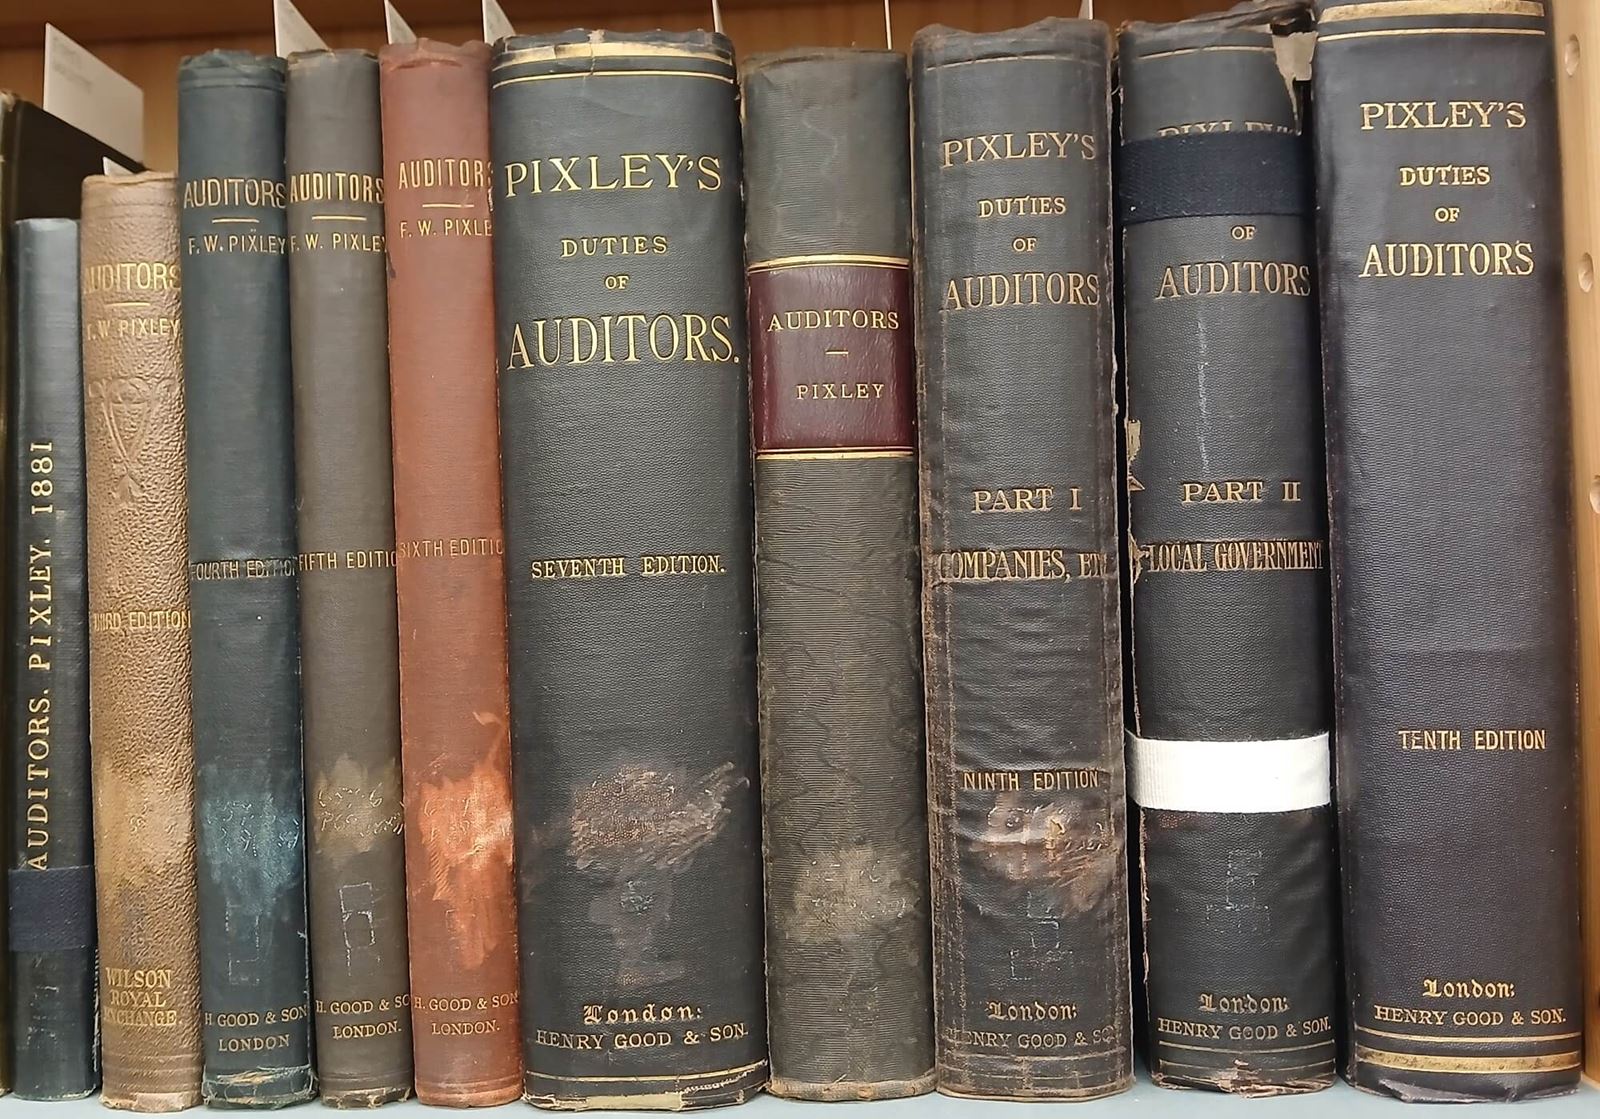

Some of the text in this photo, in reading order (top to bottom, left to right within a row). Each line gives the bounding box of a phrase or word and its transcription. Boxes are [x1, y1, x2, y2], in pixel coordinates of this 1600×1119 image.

[1360, 101, 1527, 130] PIXLEY'S
[941, 132, 1097, 169] PIXLEY'S
[504, 154, 722, 198] PIXLEY'S
[1399, 165, 1490, 186] DUTIES
[183, 178, 288, 209] AUDITORS
[289, 172, 384, 204] AUDITORS
[978, 196, 1067, 218] DUTIES
[1434, 207, 1460, 222] OF
[400, 222, 412, 238] F.
[418, 220, 437, 236] W.
[1231, 226, 1257, 240] OF
[188, 235, 286, 255] F. W. PIXLEY
[290, 235, 300, 252] F.
[305, 233, 323, 250] W.
[561, 236, 668, 258] DUTIES
[1012, 237, 1037, 252] OF
[1358, 242, 1535, 278] AUDITORS
[605, 275, 630, 290] OF
[1155, 261, 1312, 300] AUDITORS
[943, 272, 1101, 311] AUDITORS
[119, 318, 180, 338] PIXLEY
[767, 309, 900, 332] AUDITORS
[506, 313, 740, 370] AUDITORS.
[796, 383, 885, 400] PIXLEY
[30, 442, 53, 515] 1881
[971, 488, 1082, 514] PART I
[1182, 481, 1301, 504] PART II
[398, 540, 444, 559] SIXTH
[1148, 540, 1324, 573] LOCAL GOVERNMENT
[190, 561, 239, 580] FOURTH
[299, 552, 338, 571] FIFTH
[531, 554, 726, 579] SEVENTH EDITION.
[129, 610, 191, 631] EDITION
[1398, 729, 1546, 750] TENTH EDITION
[27, 689, 50, 871] AUDITORS.
[963, 770, 1099, 791] NINTH EDITION
[105, 967, 172, 989] WILSON
[109, 989, 167, 1008] ROYAL
[316, 1000, 327, 1013] H.
[330, 1000, 373, 1014] GOOD
[379, 999, 390, 1011] &
[414, 996, 425, 1009] H.
[429, 998, 472, 1012] GOOD
[476, 997, 487, 1010] &
[217, 1013, 260, 1027] GOOD
[265, 1011, 276, 1025] &
[281, 1004, 307, 1022] SON
[1373, 1005, 1566, 1026] HENRY GOOD & SON.
[332, 1020, 402, 1039] LONDON.
[431, 1019, 500, 1036] LONDON.
[1157, 1016, 1332, 1040] HENRY GOOD & SON.
[219, 1034, 290, 1052] LONDON
[535, 1029, 604, 1050] HENRY
[614, 1032, 672, 1049] GOOD
[683, 1030, 700, 1045] &
[1017, 1033, 1067, 1049] GOOD
[1074, 1032, 1088, 1047] &
